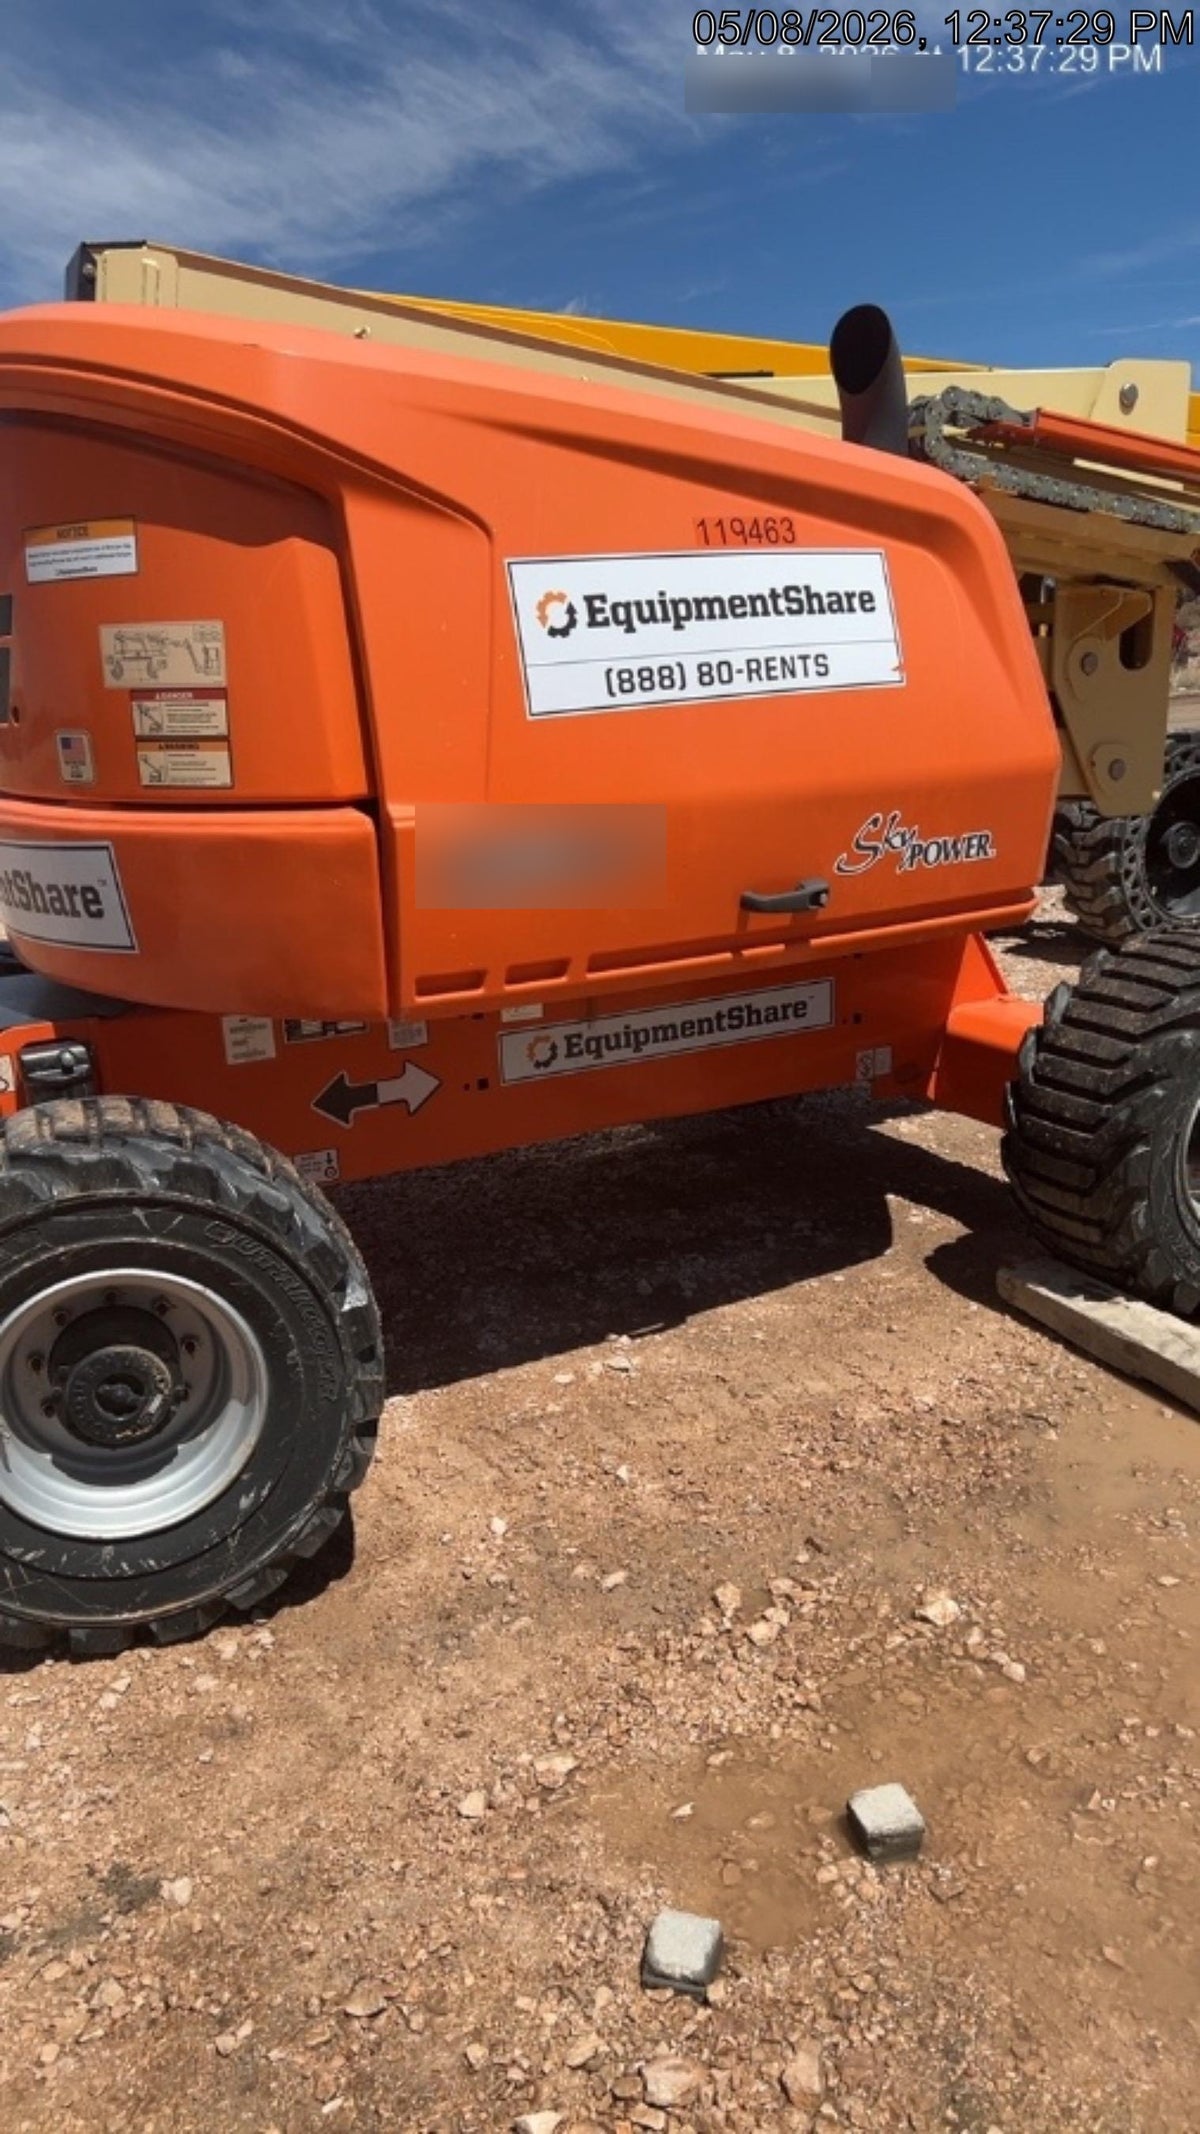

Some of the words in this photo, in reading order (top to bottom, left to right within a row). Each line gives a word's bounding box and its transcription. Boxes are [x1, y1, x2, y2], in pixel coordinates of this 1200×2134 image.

[696, 516, 796, 546] 119463
[582, 584, 877, 634] EquipmentShare
[605, 661, 686, 698] (888)
[696, 653, 830, 687] 80-RENTS
[832, 810, 919, 876] Sky
[907, 830, 993, 871] POWER
[563, 999, 808, 1060] EquipmentShare
